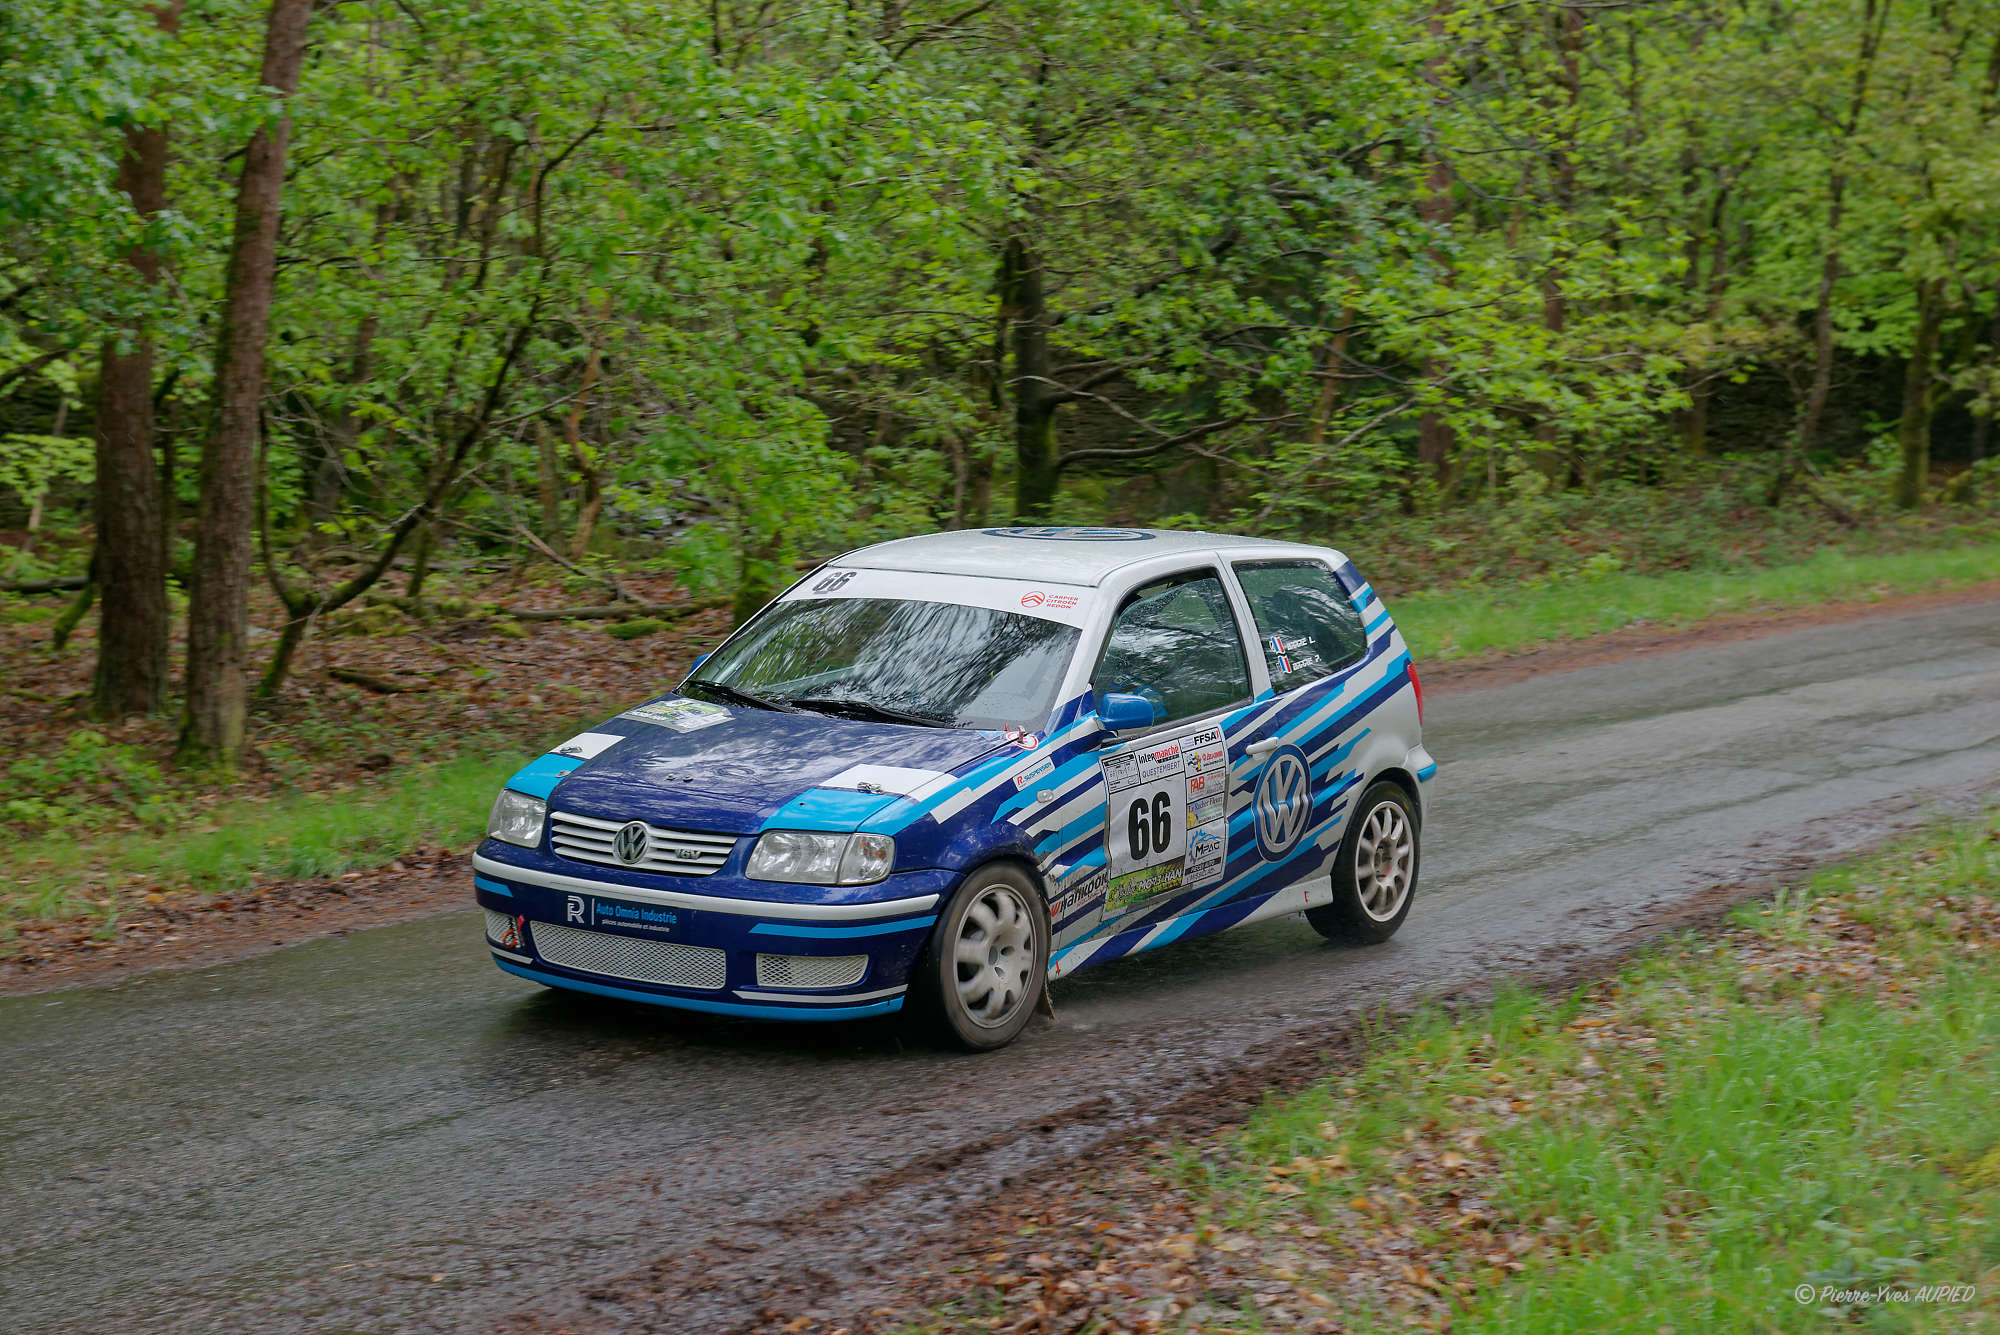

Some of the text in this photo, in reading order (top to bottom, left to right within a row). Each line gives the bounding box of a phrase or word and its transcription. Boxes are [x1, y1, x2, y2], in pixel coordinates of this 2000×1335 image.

[812, 571, 856, 594] 66
[1193, 733, 1217, 746] FFSA
[1142, 760, 1181, 778] QUESTEMBERT
[1190, 775, 1205, 793] FAB
[1128, 791, 1171, 861] 66
[596, 903, 677, 924] Auto Omnia Industrie
